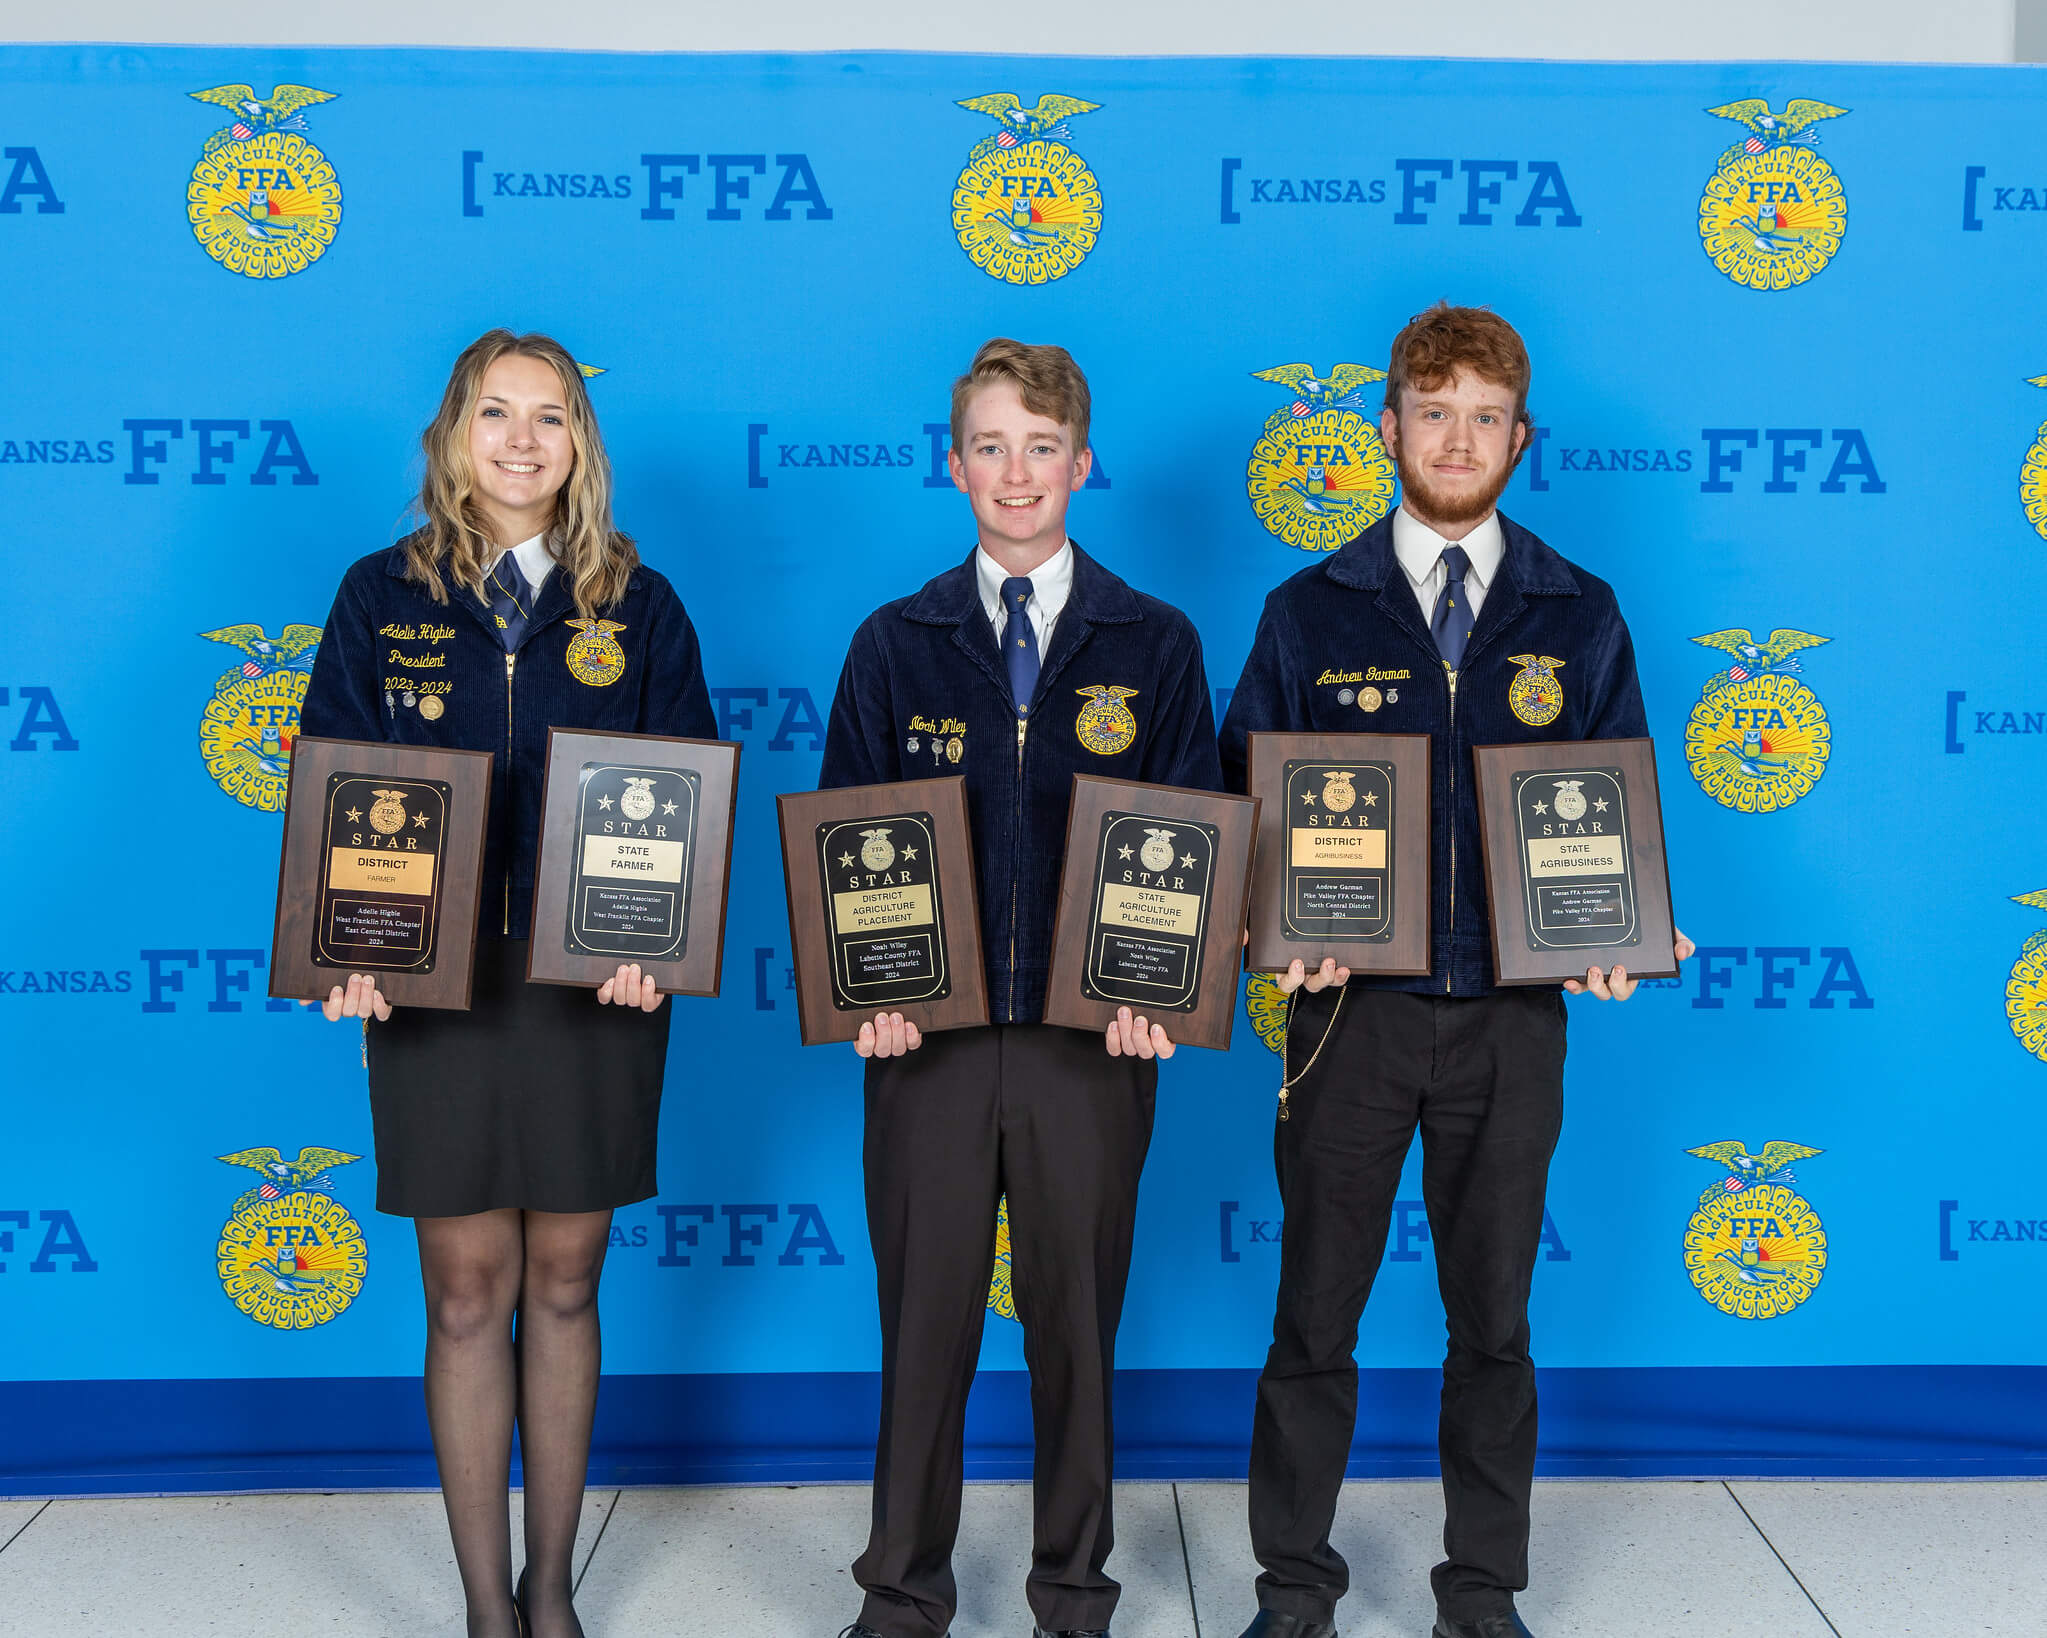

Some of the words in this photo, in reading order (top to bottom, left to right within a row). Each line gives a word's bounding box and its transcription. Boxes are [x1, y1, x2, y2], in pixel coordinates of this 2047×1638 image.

[212, 149, 317, 194] AGRICULTURAL
[236, 169, 295, 190] FFA
[977, 157, 1079, 202] AGRICULTURAL
[493, 172, 632, 199] KANSAS
[640, 153, 833, 221] FFA
[1000, 176, 1057, 198] FFA
[1250, 179, 1386, 203] KANSAS
[1393, 158, 1582, 227] FFA
[1724, 163, 1824, 207] AGRICULTURAL
[1747, 182, 1803, 203] FFA
[220, 228, 311, 257] EDUCATION
[984, 235, 1071, 263] EDUCATION
[1729, 241, 1815, 269] EDUCATION
[122, 418, 319, 486] FFA
[777, 444, 914, 468] KANSAS
[1271, 426, 1372, 470] AGRICULTURAL
[1295, 445, 1351, 466] FFA
[1559, 449, 1692, 472] KANSAS
[1700, 428, 1887, 494] FFA
[1278, 502, 1365, 531] EDUCATION
[379, 623, 416, 640] Adelle
[388, 649, 446, 668] President
[586, 647, 607, 655] FFA
[384, 676, 453, 694] 2023-2024
[1316, 667, 1363, 686] Andrew
[1365, 666, 1411, 681] Garman
[248, 705, 301, 726] FFA
[710, 687, 827, 751] FA
[1097, 714, 1117, 723] FFA
[1709, 690, 1808, 732] AGRICULTURAL
[1732, 709, 1787, 729] FFA
[909, 715, 936, 734] Noah
[938, 717, 966, 738] Wiley
[1715, 765, 1801, 793] EDUCATION
[603, 820, 668, 837] STAR
[1309, 814, 1369, 827] STAR
[1543, 822, 1603, 836] STAR
[352, 832, 418, 850] STAR
[617, 845, 650, 857] STATE
[1315, 837, 1363, 846] DISTRICT
[1560, 844, 1590, 854] STATE
[357, 857, 409, 870] DISTRICT
[611, 859, 654, 871] FARMER
[1314, 852, 1363, 860] AGRIBUSINESS
[1540, 857, 1613, 869] AGRIBUSINESS
[367, 874, 396, 884] FARMER
[849, 870, 912, 889] STAR
[1122, 869, 1185, 890] STAR
[862, 891, 903, 903] DISTRICT
[1138, 892, 1166, 903] STATE
[1325, 902, 1347, 910] Central
[1351, 893, 1375, 901] Chapter
[852, 901, 915, 916] AGRICULTURE
[1119, 901, 1182, 917] AGRICULTURE
[380, 919, 393, 927] FFA
[395, 920, 421, 930] Chapter
[857, 913, 913, 926] PLACEMENT
[1121, 913, 1177, 928] PLACEMENT
[345, 926, 359, 934] East
[360, 927, 384, 936] Central
[385, 929, 409, 938] District
[884, 951, 907, 961] County
[908, 949, 921, 957] FFA
[863, 962, 894, 972] Southeast
[895, 960, 920, 968] District
[0, 970, 132, 993] KANSAS
[140, 949, 322, 1013] FF
[1691, 946, 1874, 1009] FFA
[240, 1208, 344, 1250] AGRICULTURAL
[1706, 1200, 1805, 1241] AGRICULTURAL
[1729, 1218, 1784, 1238] FFA
[265, 1226, 322, 1246] FFA
[656, 1203, 845, 1267] FFA
[250, 1282, 337, 1309] EDUCATION
[1714, 1272, 1799, 1300] EDUCATION
